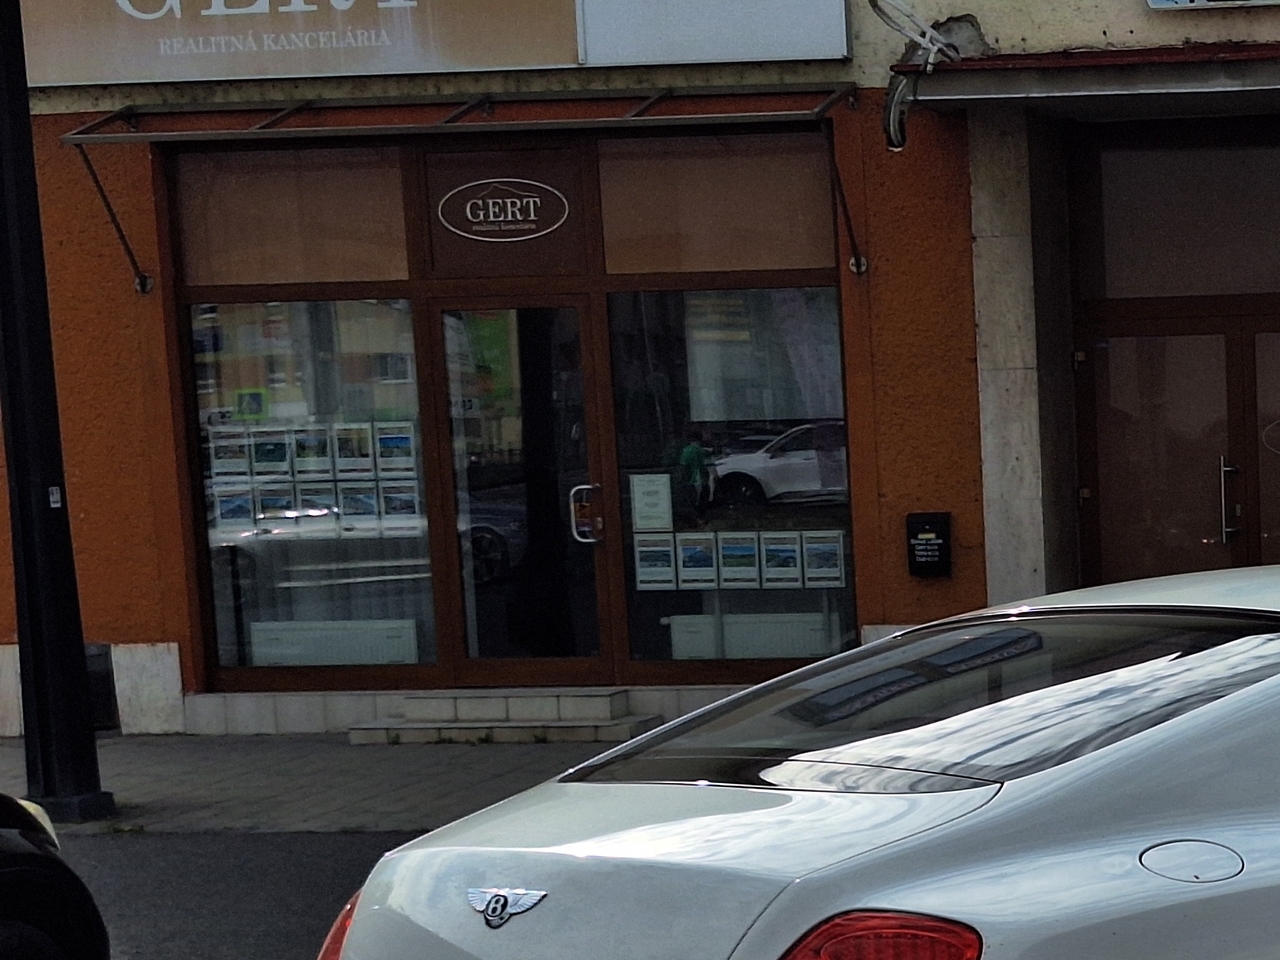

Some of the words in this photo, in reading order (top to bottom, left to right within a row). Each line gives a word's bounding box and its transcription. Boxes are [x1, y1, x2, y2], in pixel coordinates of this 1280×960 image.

[158, 30, 257, 55] REALITNÁ
[262, 26, 392, 52] KANCELÁRIA
[465, 197, 541, 222] GERT
